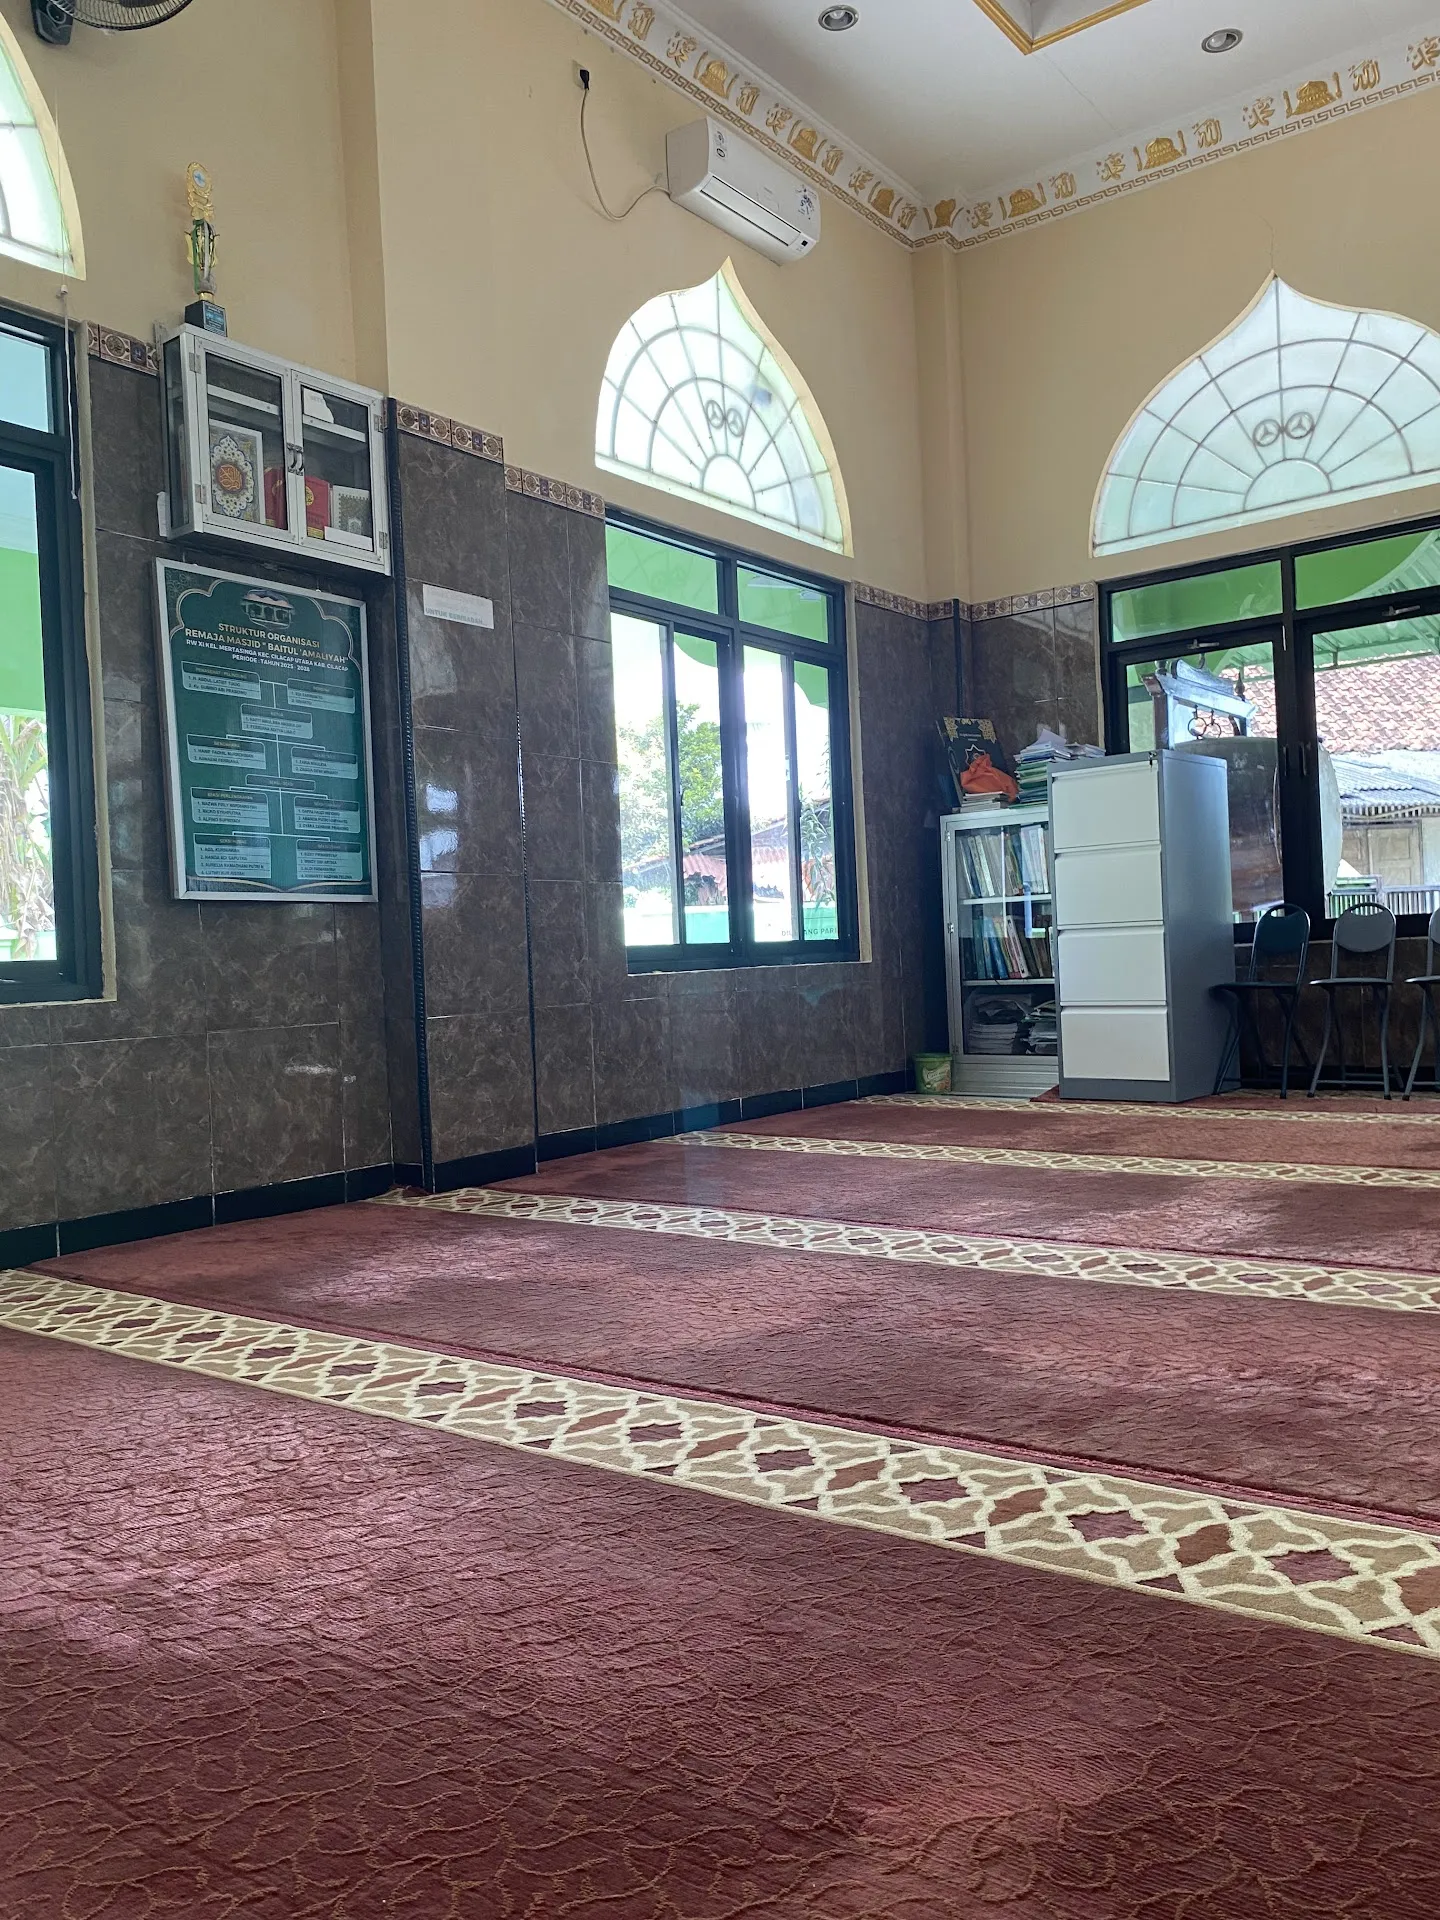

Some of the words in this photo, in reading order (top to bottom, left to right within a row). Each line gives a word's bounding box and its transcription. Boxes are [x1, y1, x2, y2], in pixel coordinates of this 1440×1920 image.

[185, 628, 224, 642] REMAJA
[226, 635, 260, 648] MASJID
[267, 642, 298, 655] BAITUL
[218, 623, 265, 638] STRUKTUR
[267, 632, 319, 648] ORGANISASI
[232, 654, 257, 663] PERIODE
[260, 658, 279, 666] TAHUN
[271, 654, 294, 662] CILACAP
[326, 663, 348, 671] CILACAP
